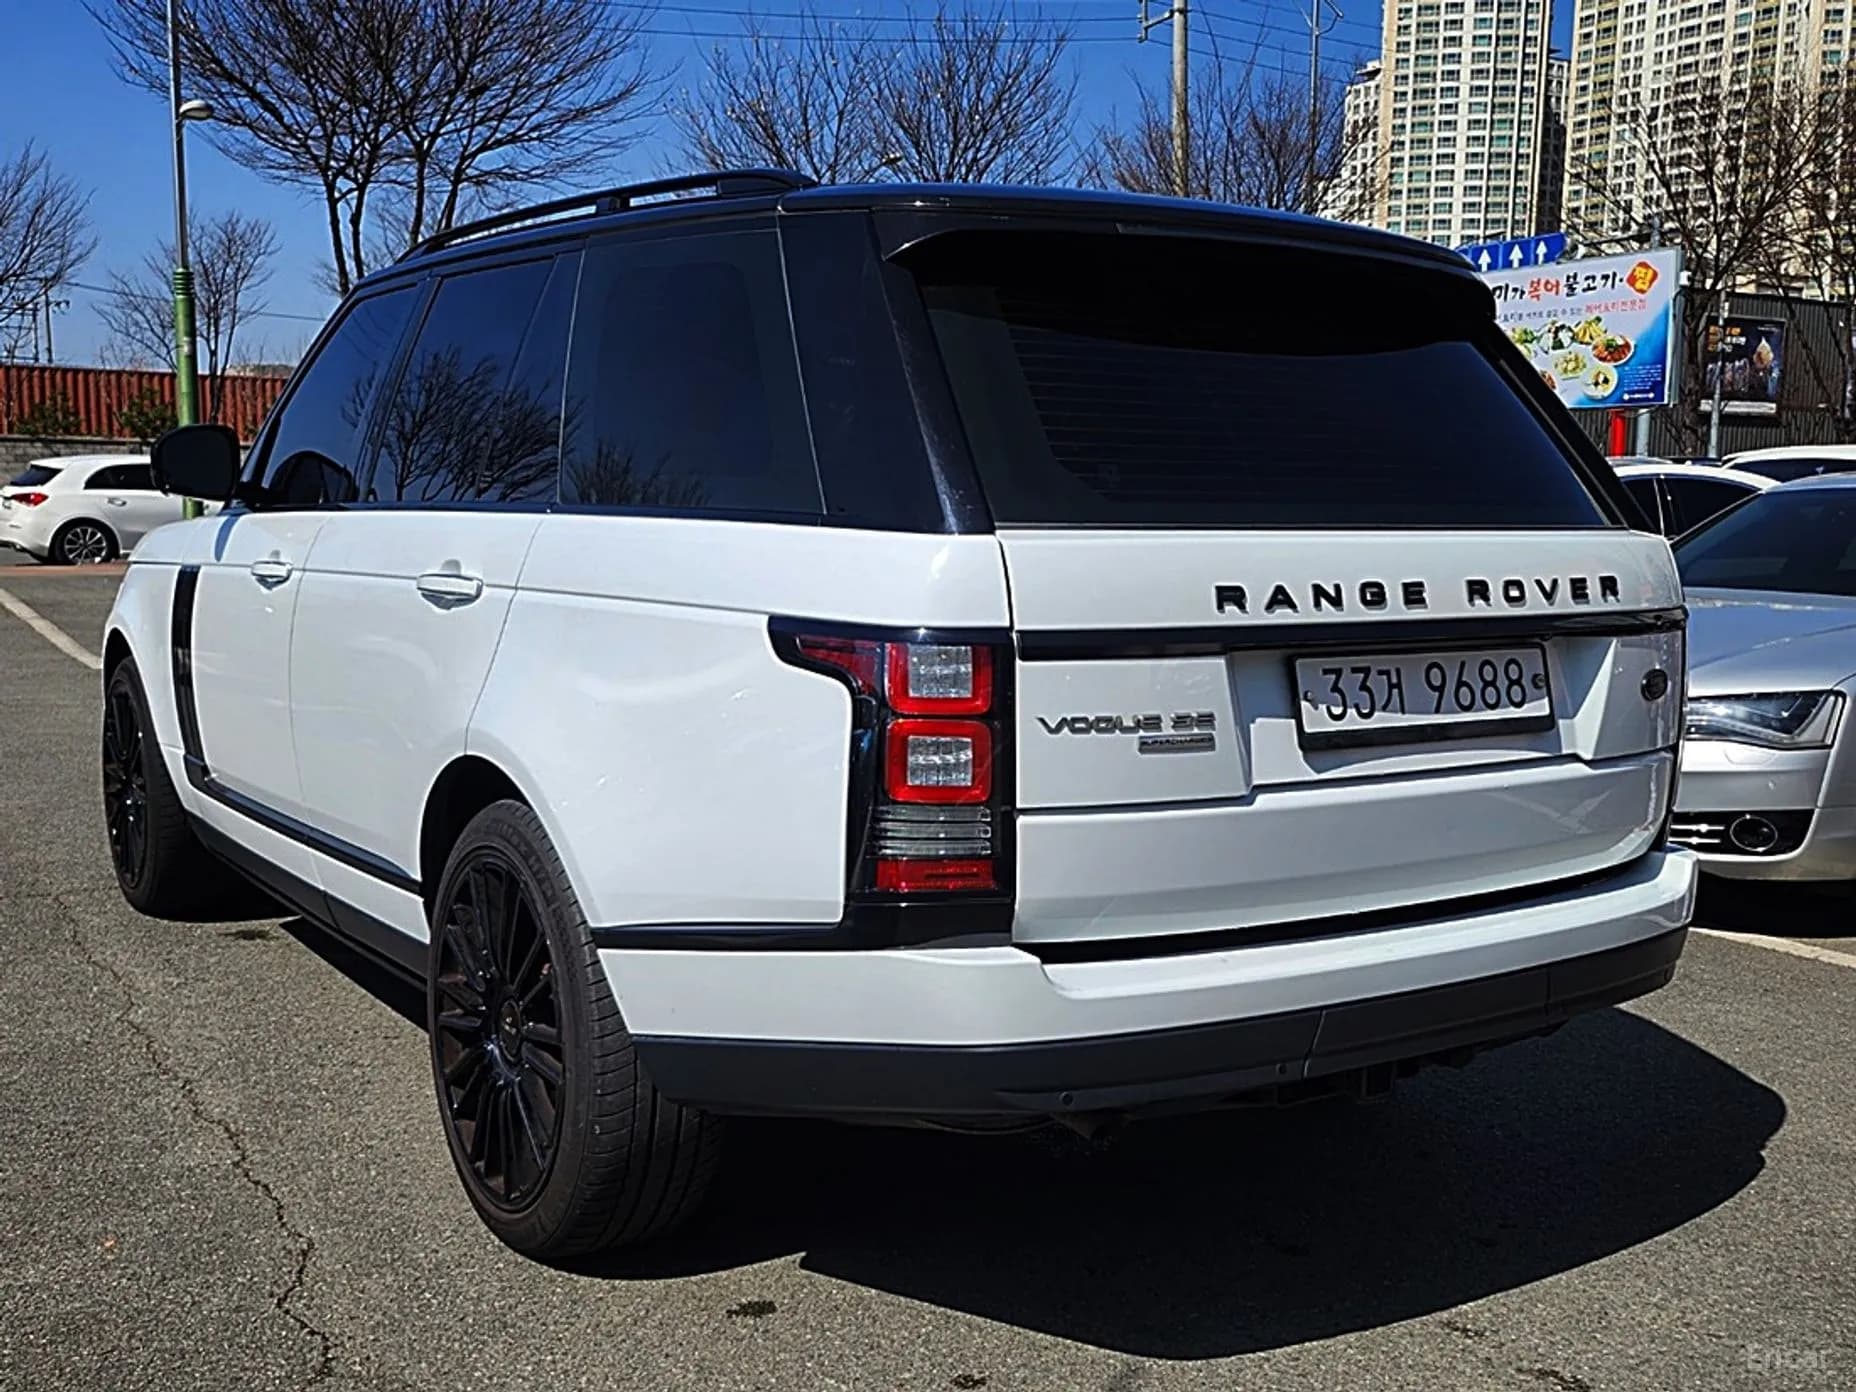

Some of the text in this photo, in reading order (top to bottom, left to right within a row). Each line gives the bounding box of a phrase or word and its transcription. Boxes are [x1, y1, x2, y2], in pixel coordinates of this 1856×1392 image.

[1214, 574, 1621, 614] RANGE ROVER
[1321, 657, 1527, 722] 33거 9688
[1036, 713, 1163, 735] VOGUE
